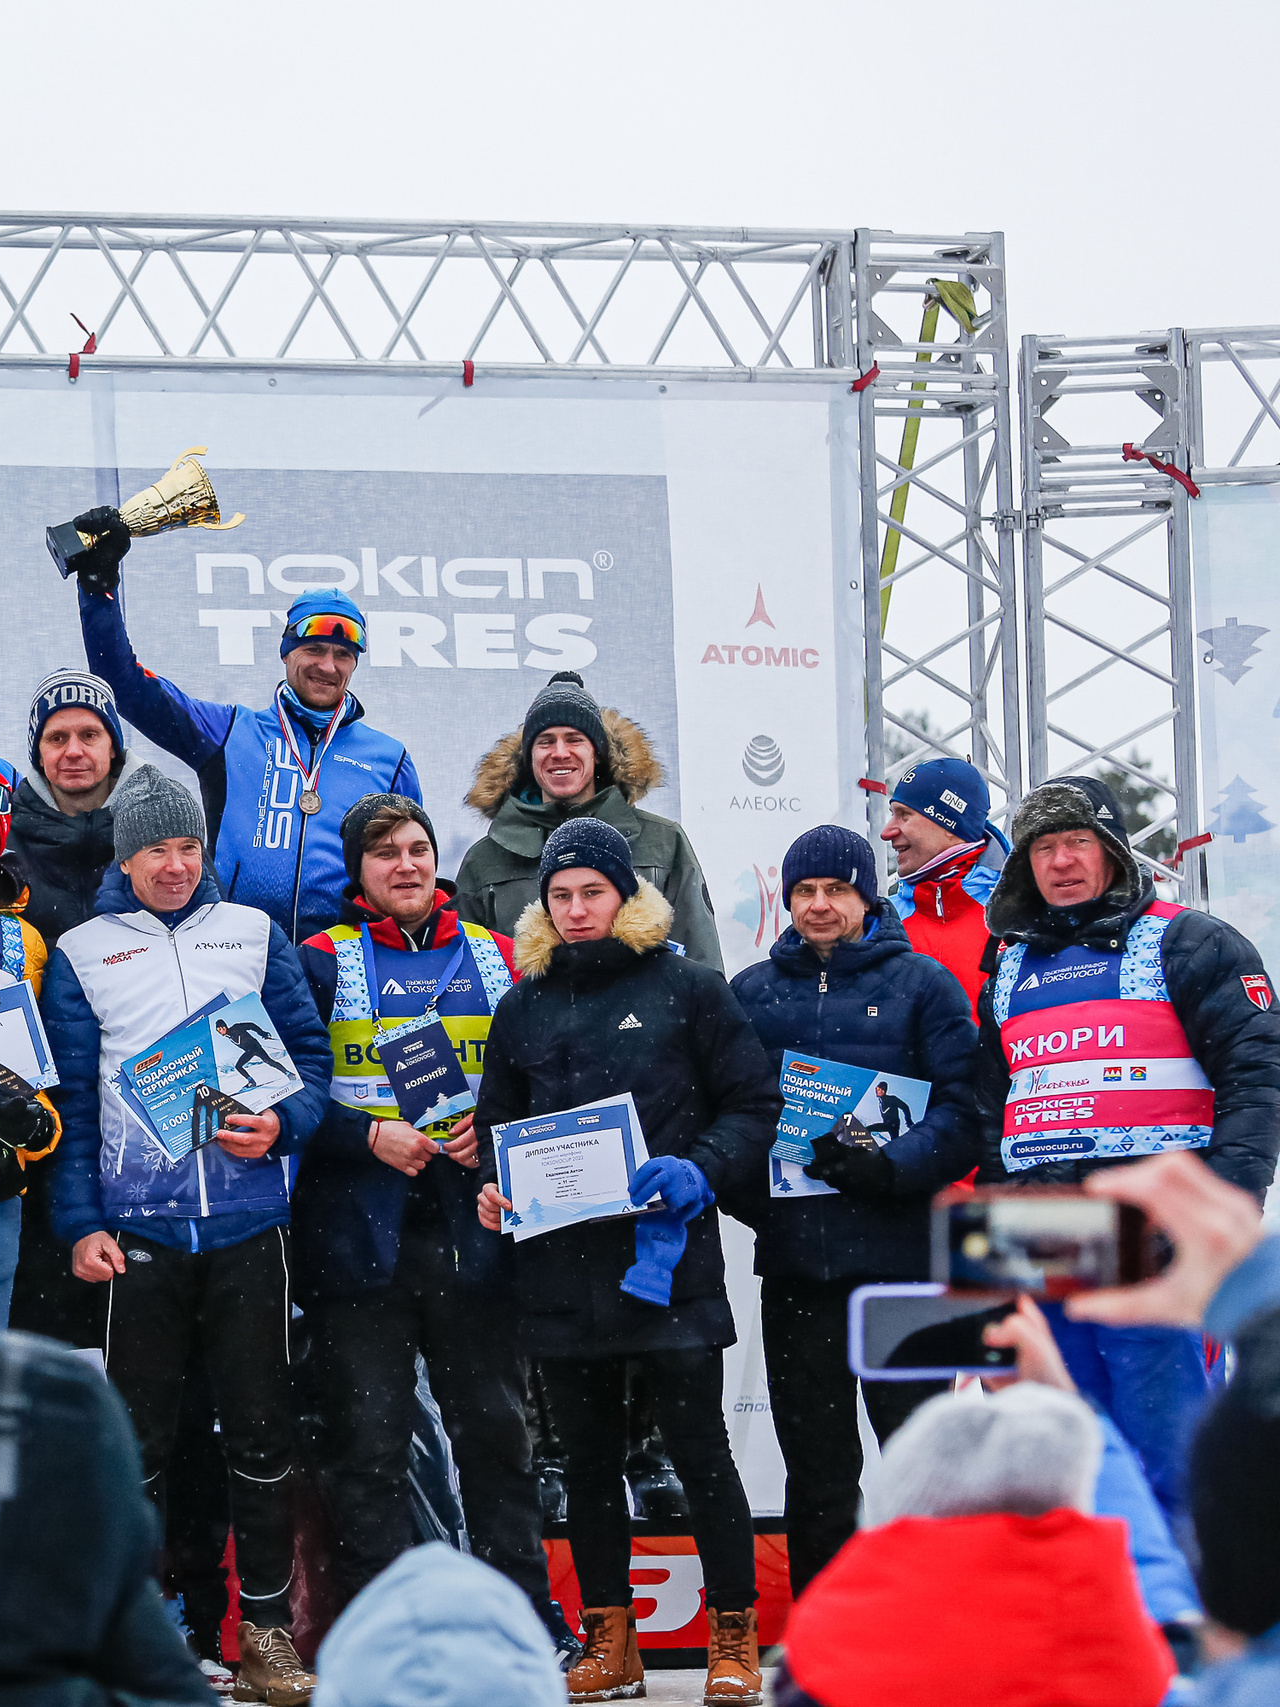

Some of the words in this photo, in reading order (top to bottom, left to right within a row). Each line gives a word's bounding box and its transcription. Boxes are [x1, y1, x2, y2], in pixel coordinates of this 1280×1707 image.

[199, 609, 597, 671] TRES
[700, 644, 820, 669] ATOMIC
[43, 685, 109, 715] YORK
[729, 796, 802, 812] АЛЕОКС
[944, 793, 965, 811] DNB
[1041, 966, 1108, 985] TOKSOVOCUP
[406, 984, 472, 993] TOKSOOCUP
[1008, 1025, 1124, 1064] ЖЮРИ
[136, 1046, 204, 1088] ПОДАРОЧНЫЙ
[141, 1061, 199, 1097] СЕРТИФИКАТ
[404, 1066, 448, 1090] ВОЛОНТЁР
[783, 1073, 852, 1097] ПОДАРОЧНЫЙ
[196, 1086, 210, 1099] 10
[782, 1083, 840, 1105] СЕРТИФИКАТ
[161, 1122, 169, 1132] 4
[169, 1112, 189, 1128] 000
[843, 1113, 852, 1126] 7
[1014, 1107, 1094, 1126] TYRES
[782, 1123, 800, 1136] 000
[525, 1145, 556, 1158] ДИПЛОМ
[556, 1139, 600, 1151] УЧАСТНИКА
[1016, 1142, 1083, 1155] toksovocup.ru
